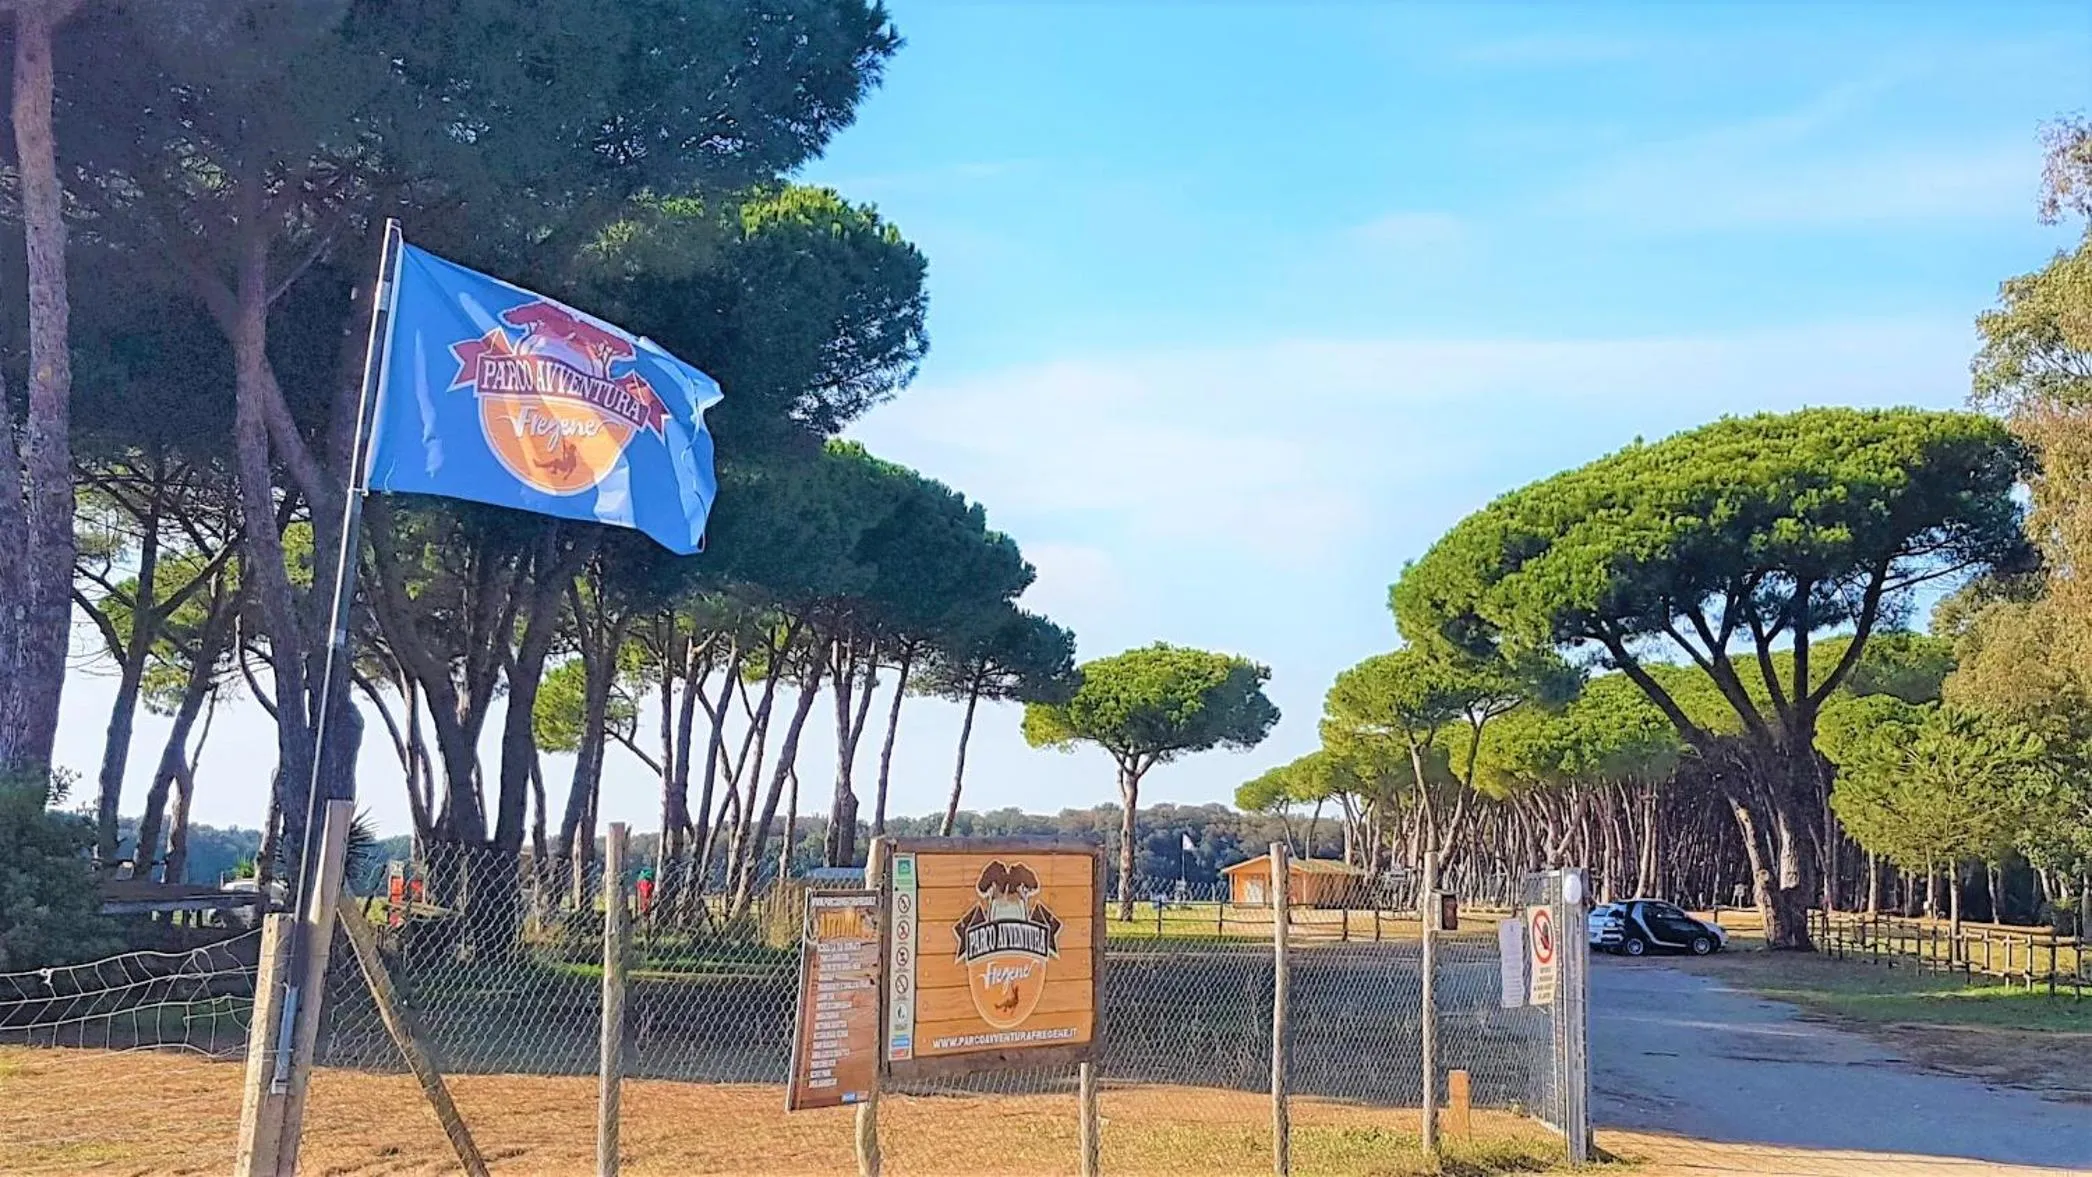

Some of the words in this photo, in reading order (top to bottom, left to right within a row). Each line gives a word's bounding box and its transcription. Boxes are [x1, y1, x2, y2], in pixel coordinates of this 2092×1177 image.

[481, 358, 534, 391] PARCO
[536, 357, 641, 421] AVVENTURA
[499, 404, 612, 450] Fregene
[968, 925, 996, 957] PARCO
[997, 923, 1046, 954] AVVENTURA
[980, 961, 1033, 994] Fregene
[932, 1027, 1078, 1049] WWW.PARCOAVVENTURAFREGENE.IT
